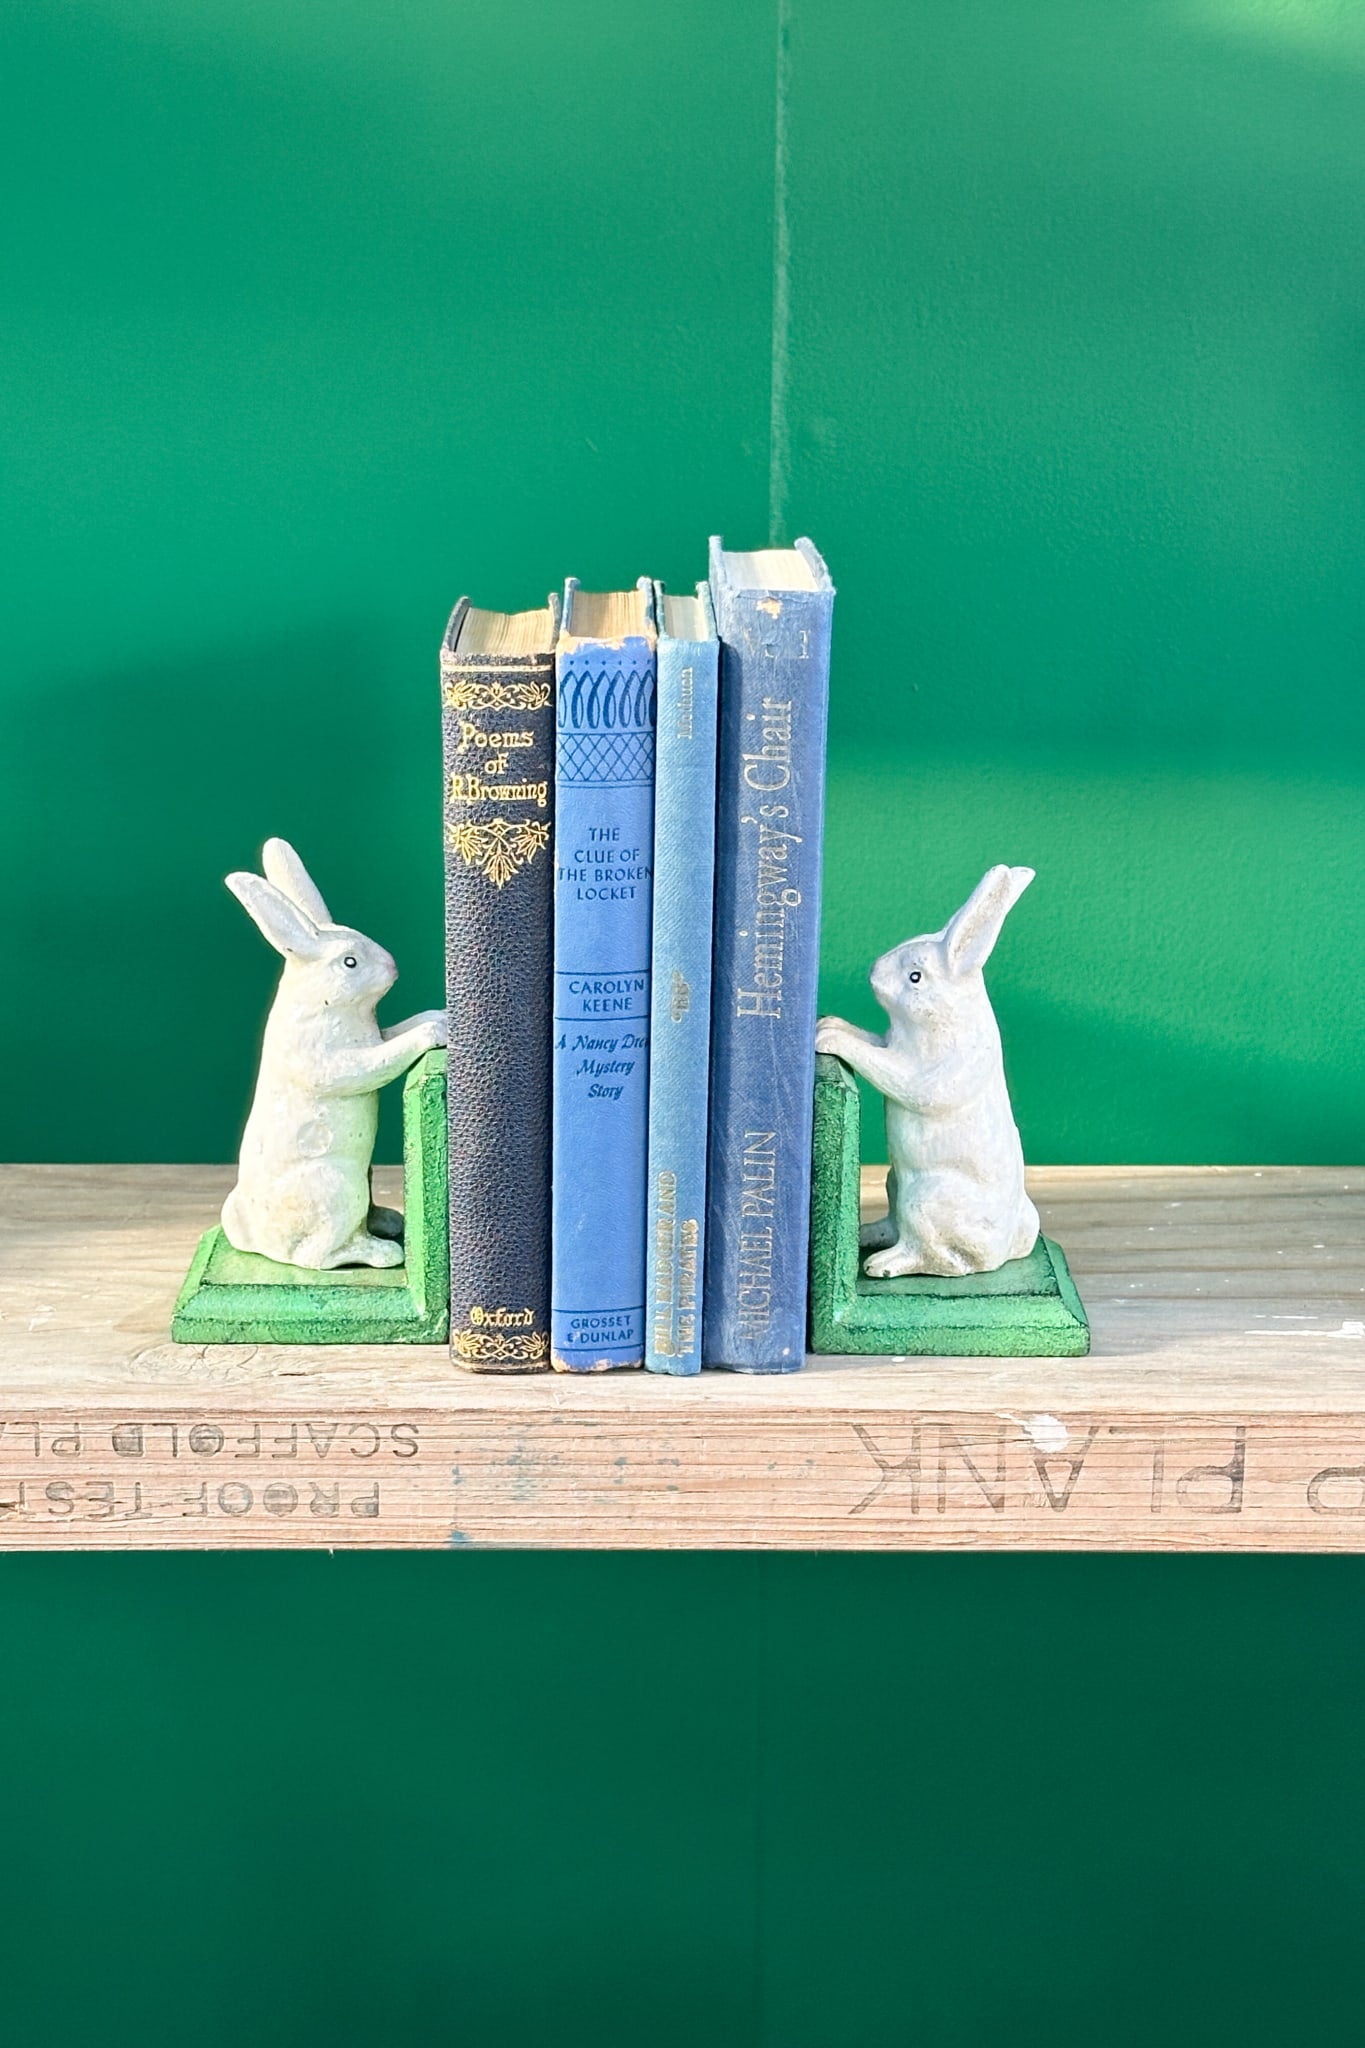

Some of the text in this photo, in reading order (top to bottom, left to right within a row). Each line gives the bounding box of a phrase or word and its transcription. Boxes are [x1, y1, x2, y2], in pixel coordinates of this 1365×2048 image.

[457, 720, 534, 752] Poems
[742, 696, 792, 791] Chair
[484, 752, 509, 774] of
[588, 827, 620, 841] THE
[574, 848, 640, 863] CLUE OF
[559, 866, 654, 882] THE BROKEN
[577, 886, 636, 901] LOCKET
[737, 805, 802, 1019] Hemingway's
[569, 979, 644, 995] CAROLYN
[583, 997, 633, 1012] KEENE
[555, 1034, 567, 1050] A
[571, 1034, 619, 1053] Nancy
[576, 1059, 636, 1078] Mystery
[588, 1083, 624, 1100] Story
[658, 1170, 676, 1215] AND
[738, 1129, 776, 1340] MICHAEL PALIN
[677, 1219, 699, 1357] THE PIRATES
[470, 1306, 535, 1327] Oxford
[570, 1315, 631, 1329] GROSSET
[580, 1329, 634, 1344] DUNLAP
[0, 1422, 420, 1459] SCAFFOLD PL
[848, 1424, 1247, 1516] PLANK
[182, 1482, 380, 1518] PROOF
